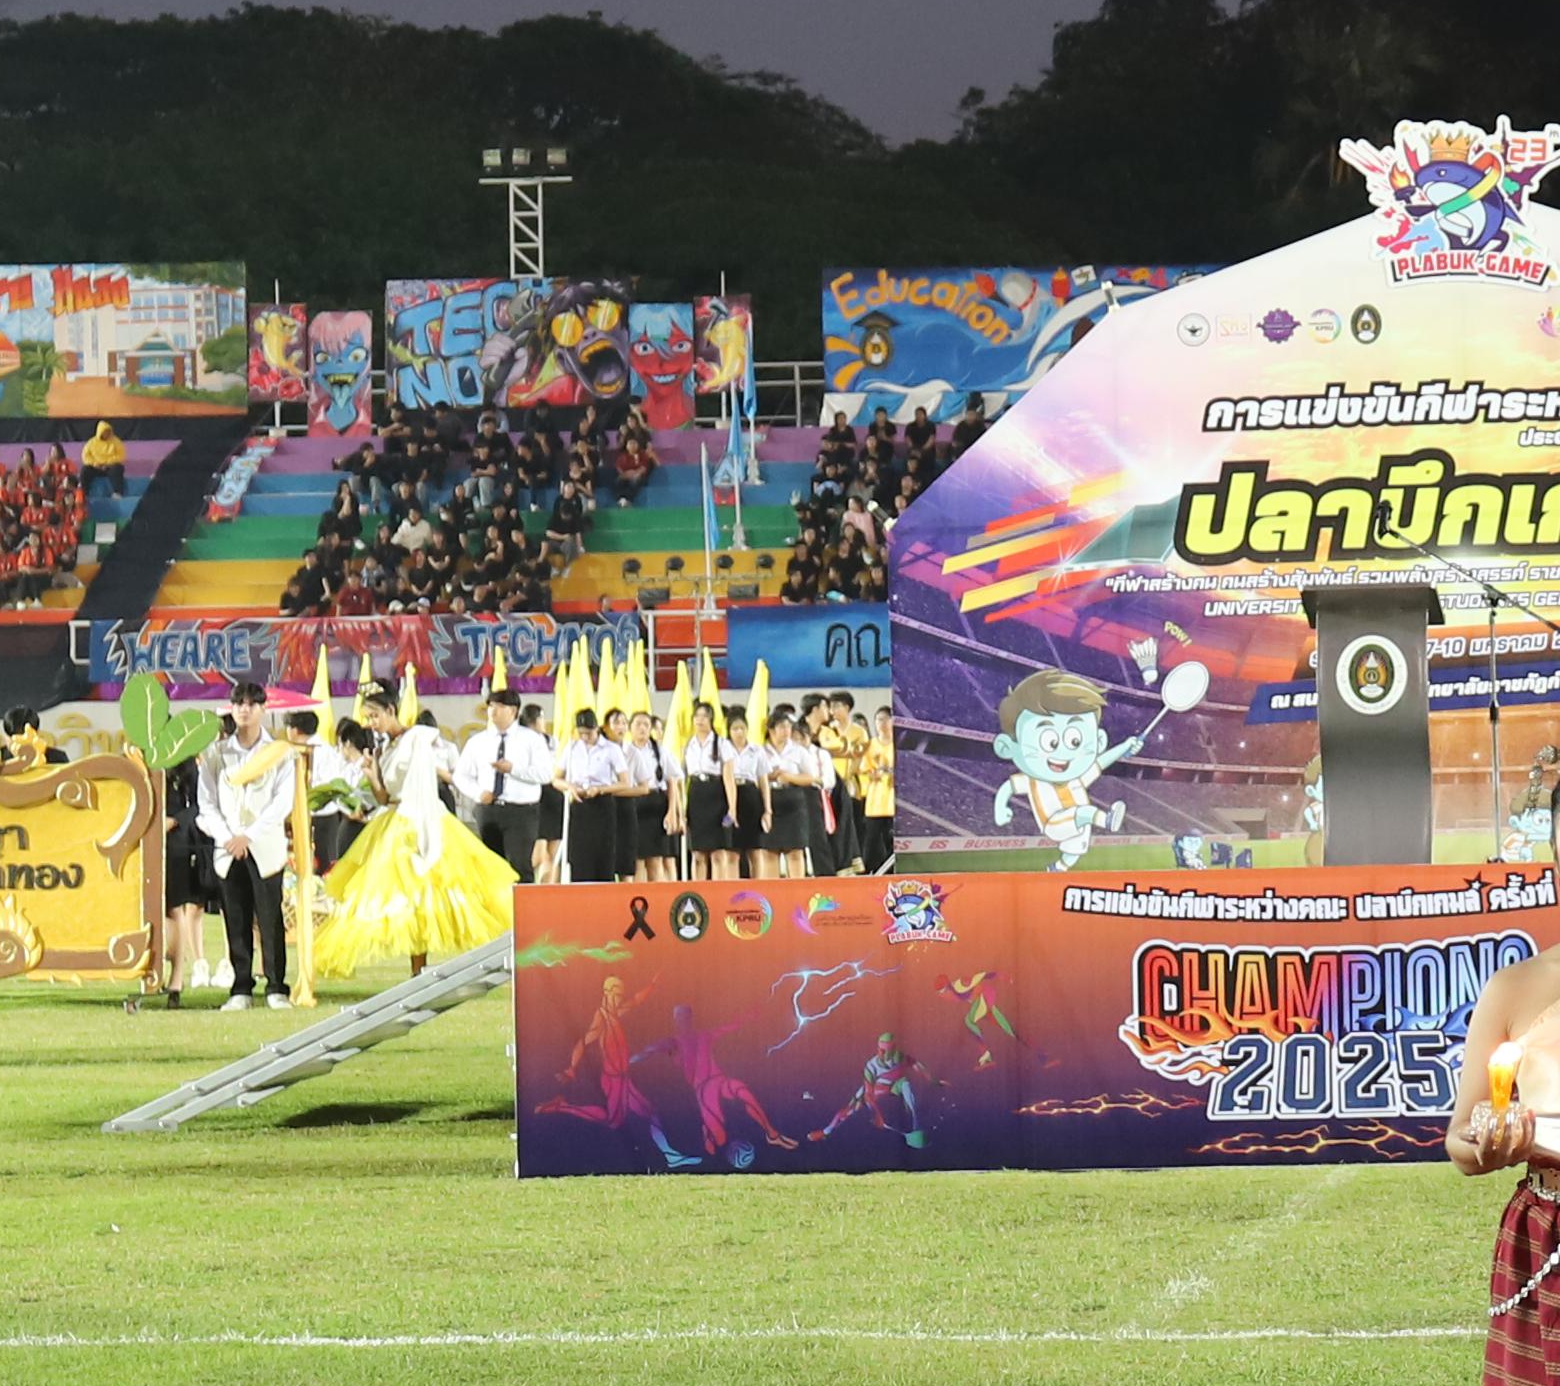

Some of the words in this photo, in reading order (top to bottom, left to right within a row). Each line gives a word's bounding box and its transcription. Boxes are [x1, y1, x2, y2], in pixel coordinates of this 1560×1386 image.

[1508, 138, 1547, 162] 23
[1396, 254, 1476, 276] PLABUK
[1485, 254, 1544, 279] GAME
[831, 268, 1012, 345] Education
[396, 356, 483, 409] NO
[1204, 600, 1306, 616] UNIVERSIT
[1163, 620, 1192, 647] POW!
[1270, 694, 1290, 711] ณ
[964, 839, 1027, 849] BUSINESS
[1064, 885, 1347, 917] การแข่งขันกีฬาระหว่างคณะ
[1490, 870, 1555, 911] ครั้งที่
[1220, 1036, 1458, 1113] 2025
